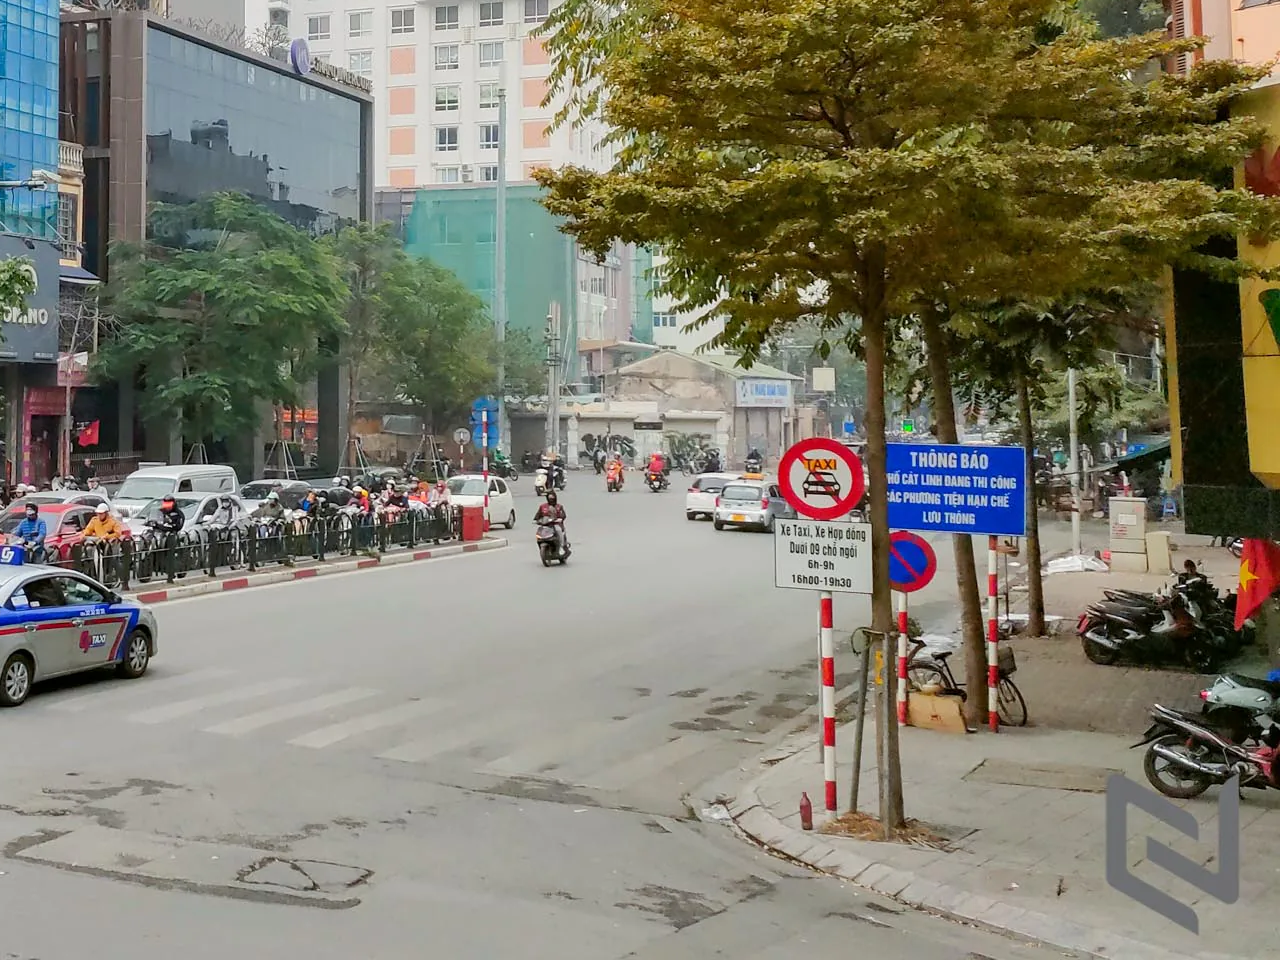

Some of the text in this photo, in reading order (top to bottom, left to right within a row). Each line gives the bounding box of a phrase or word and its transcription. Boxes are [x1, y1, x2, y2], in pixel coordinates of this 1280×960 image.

[807, 459, 837, 470] TAXI
[910, 449, 988, 469] THÔNG BÁO
[887, 470, 901, 484] HỐ
[902, 471, 918, 485] CÁT
[921, 474, 942, 486] LINH
[972, 476, 987, 488] THI
[990, 475, 1016, 489] CÔNG
[943, 491, 964, 508] TIỆN
[967, 495, 987, 508] HẠN
[990, 493, 1011, 508] CHẾ
[944, 511, 975, 524] THÔNG
[781, 524, 791, 536] Xe
[794, 525, 813, 538] Taxi,
[815, 527, 825, 538] Xe
[810, 543, 820, 555] 09
[808, 560, 834, 570] 6h-9h
[792, 574, 852, 588] 16h00-19h30
